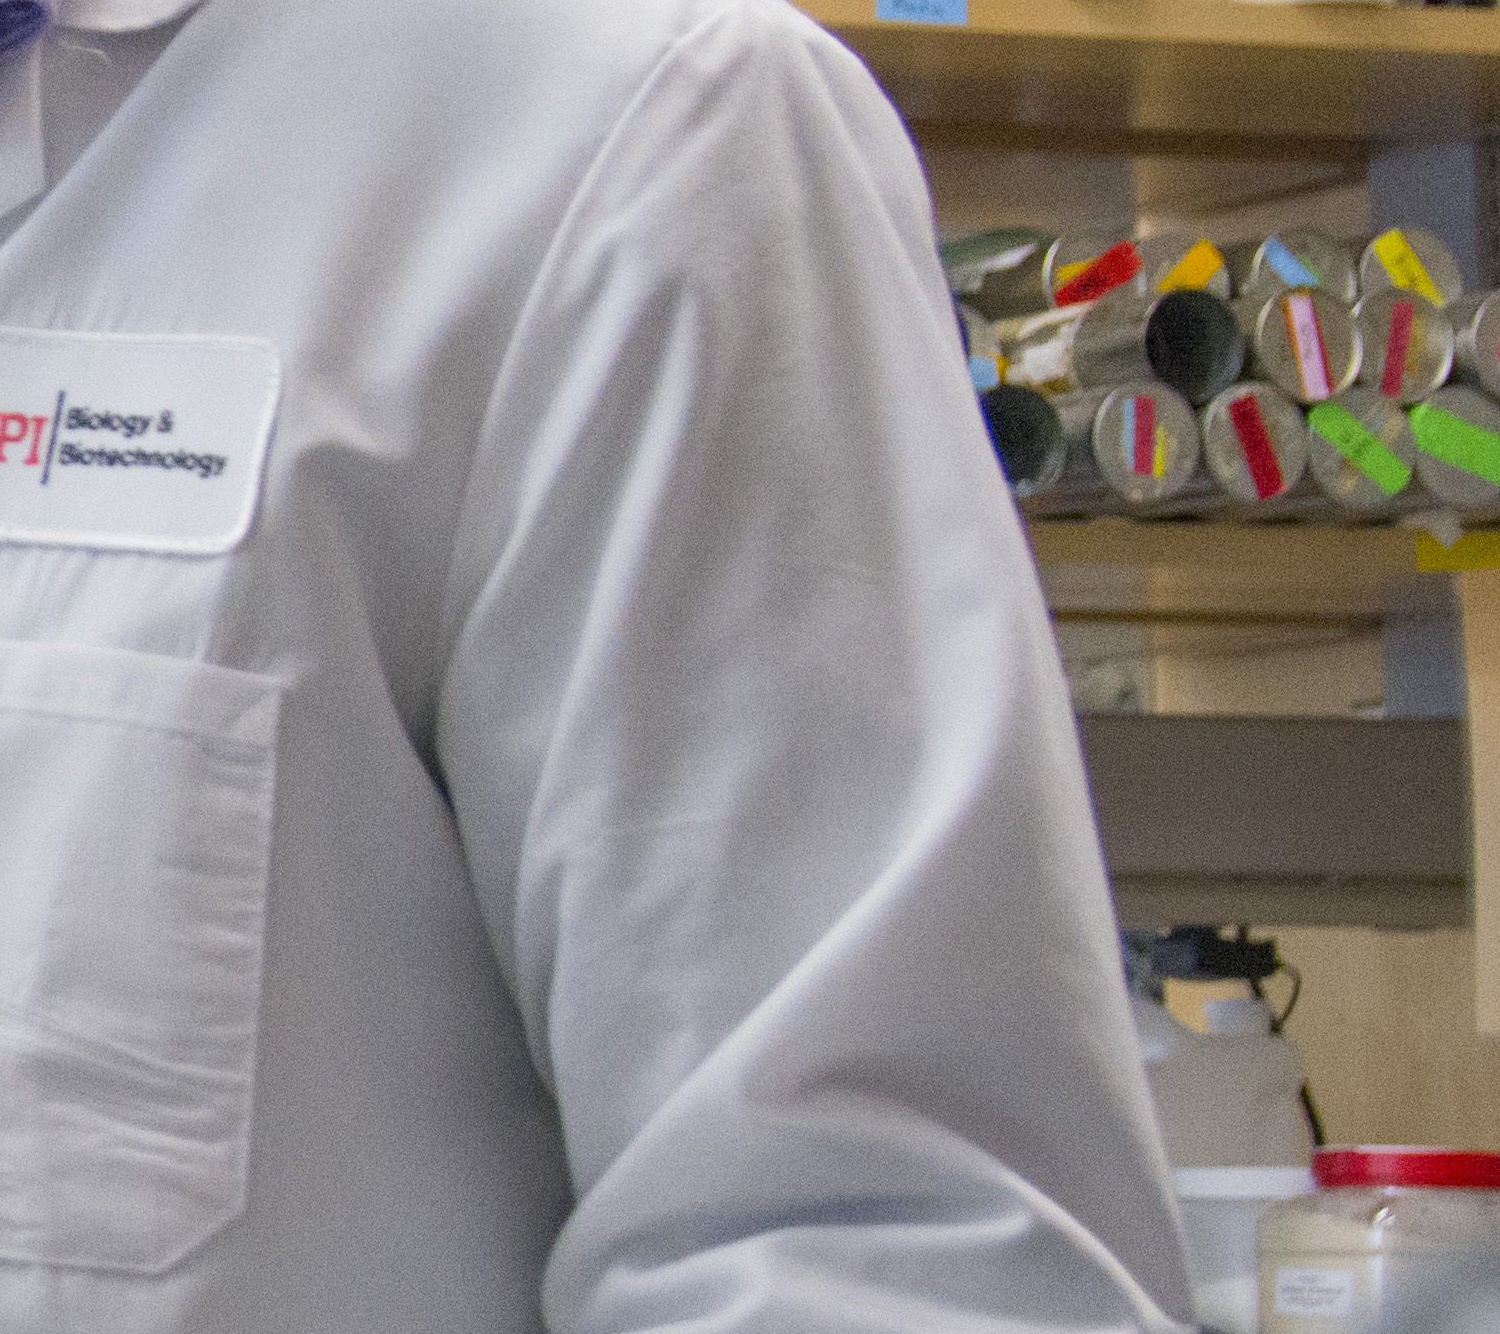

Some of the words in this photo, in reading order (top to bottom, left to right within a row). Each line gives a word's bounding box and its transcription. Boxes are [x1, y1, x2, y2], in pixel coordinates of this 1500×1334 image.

[65, 407, 152, 439] Biology
[156, 410, 175, 434] &
[58, 442, 228, 479] Biotechnology
